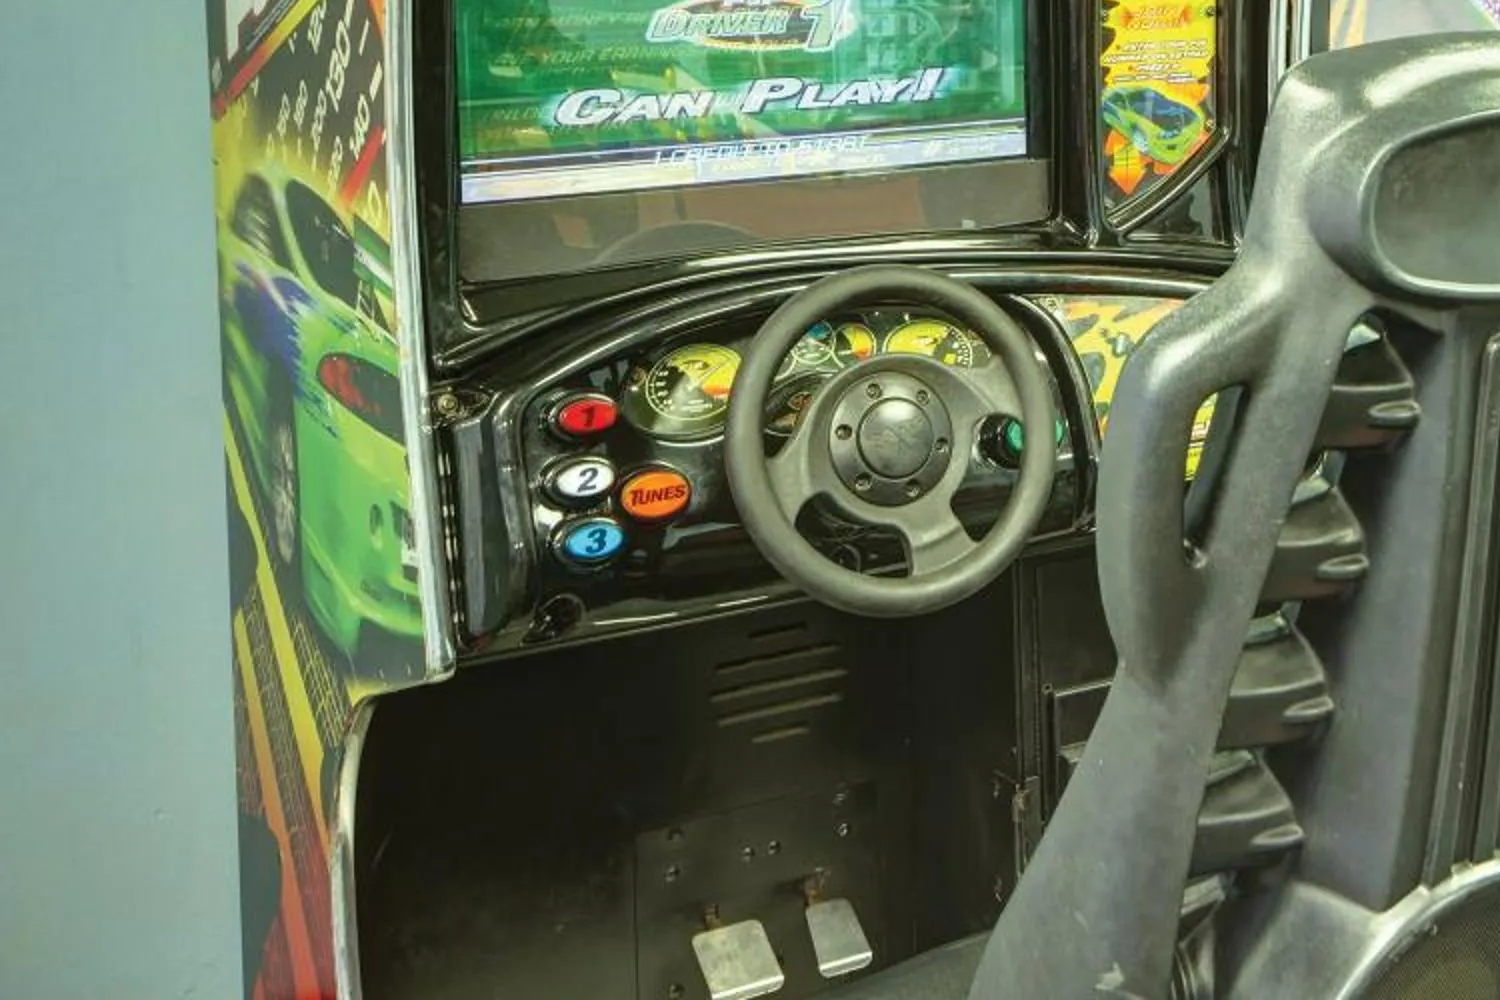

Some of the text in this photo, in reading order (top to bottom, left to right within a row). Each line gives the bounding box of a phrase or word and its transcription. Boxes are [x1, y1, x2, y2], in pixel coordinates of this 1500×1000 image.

[651, 8, 792, 39] DRIVER
[326, 19, 351, 112] 130
[553, 87, 716, 127] CAN
[739, 66, 945, 113] PLAY!
[581, 406, 596, 427] 1
[577, 467, 600, 493] 2
[629, 484, 687, 507] TUNES
[585, 527, 608, 553] 3
